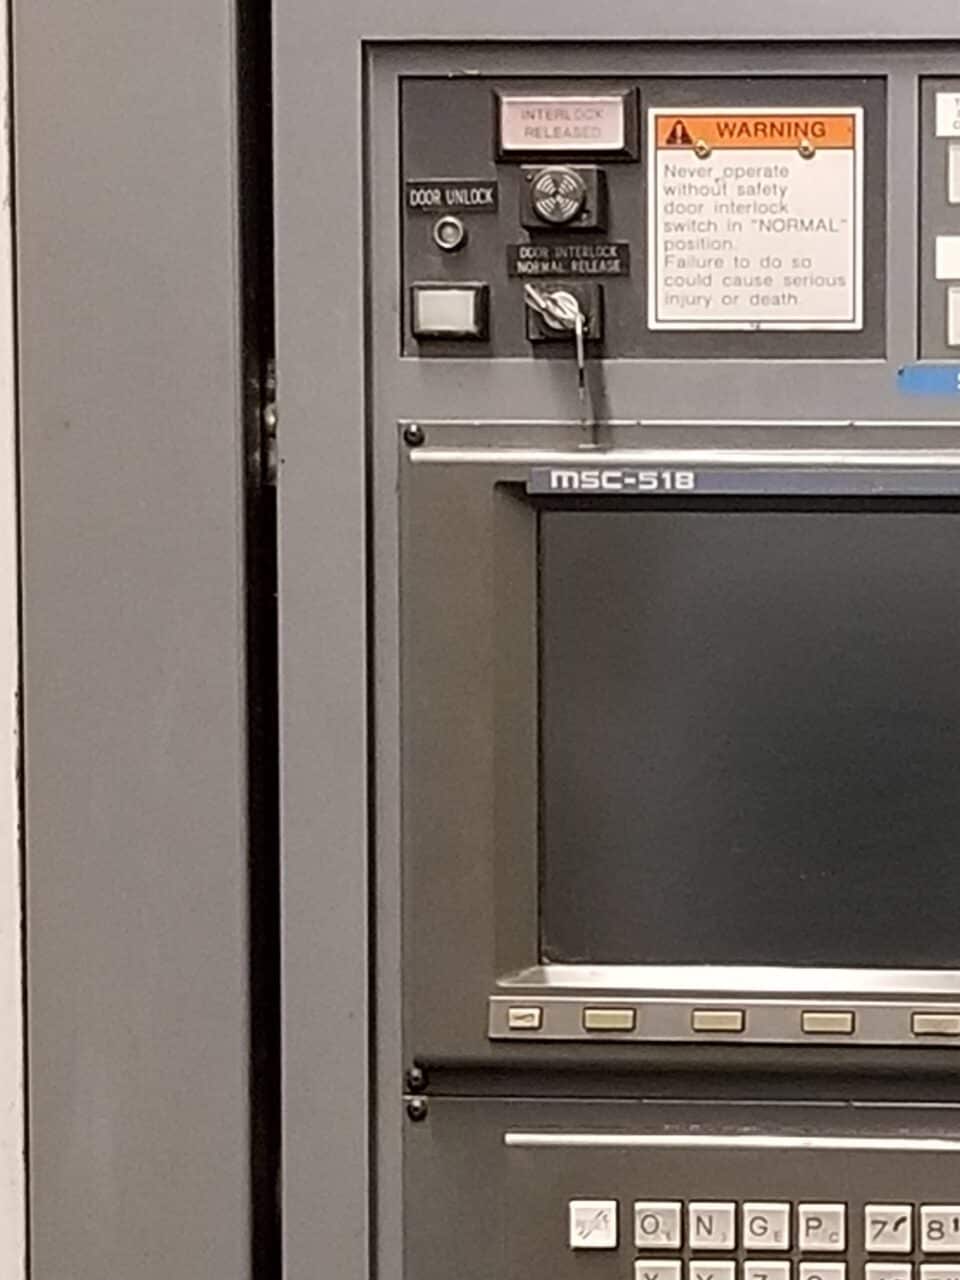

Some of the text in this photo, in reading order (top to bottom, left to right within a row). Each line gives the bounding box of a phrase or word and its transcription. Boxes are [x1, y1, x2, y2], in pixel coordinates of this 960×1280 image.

[521, 109, 603, 121] INTERLOCK
[524, 127, 600, 138] RELEASED
[716, 121, 826, 138] WARNING
[664, 165, 789, 179] Never operate
[409, 188, 493, 206] DOOR UNLOCK
[664, 183, 788, 197] without safety
[664, 202, 789, 215] door interlock
[664, 219, 717, 233] switch
[727, 219, 742, 233] in
[519, 247, 618, 259] DOOR INTERLOCK
[517, 260, 620, 273] NORMAL RELEASE
[664, 256, 812, 269] Failure to do so
[664, 275, 846, 287] could cause serious
[665, 293, 712, 308] injury
[722, 294, 739, 305] or
[696, 1215, 713, 1236] N
[750, 1216, 768, 1236] G
[805, 1217, 822, 1237] P
[871, 1220, 888, 1241] 7
[926, 1220, 945, 1241] 8
